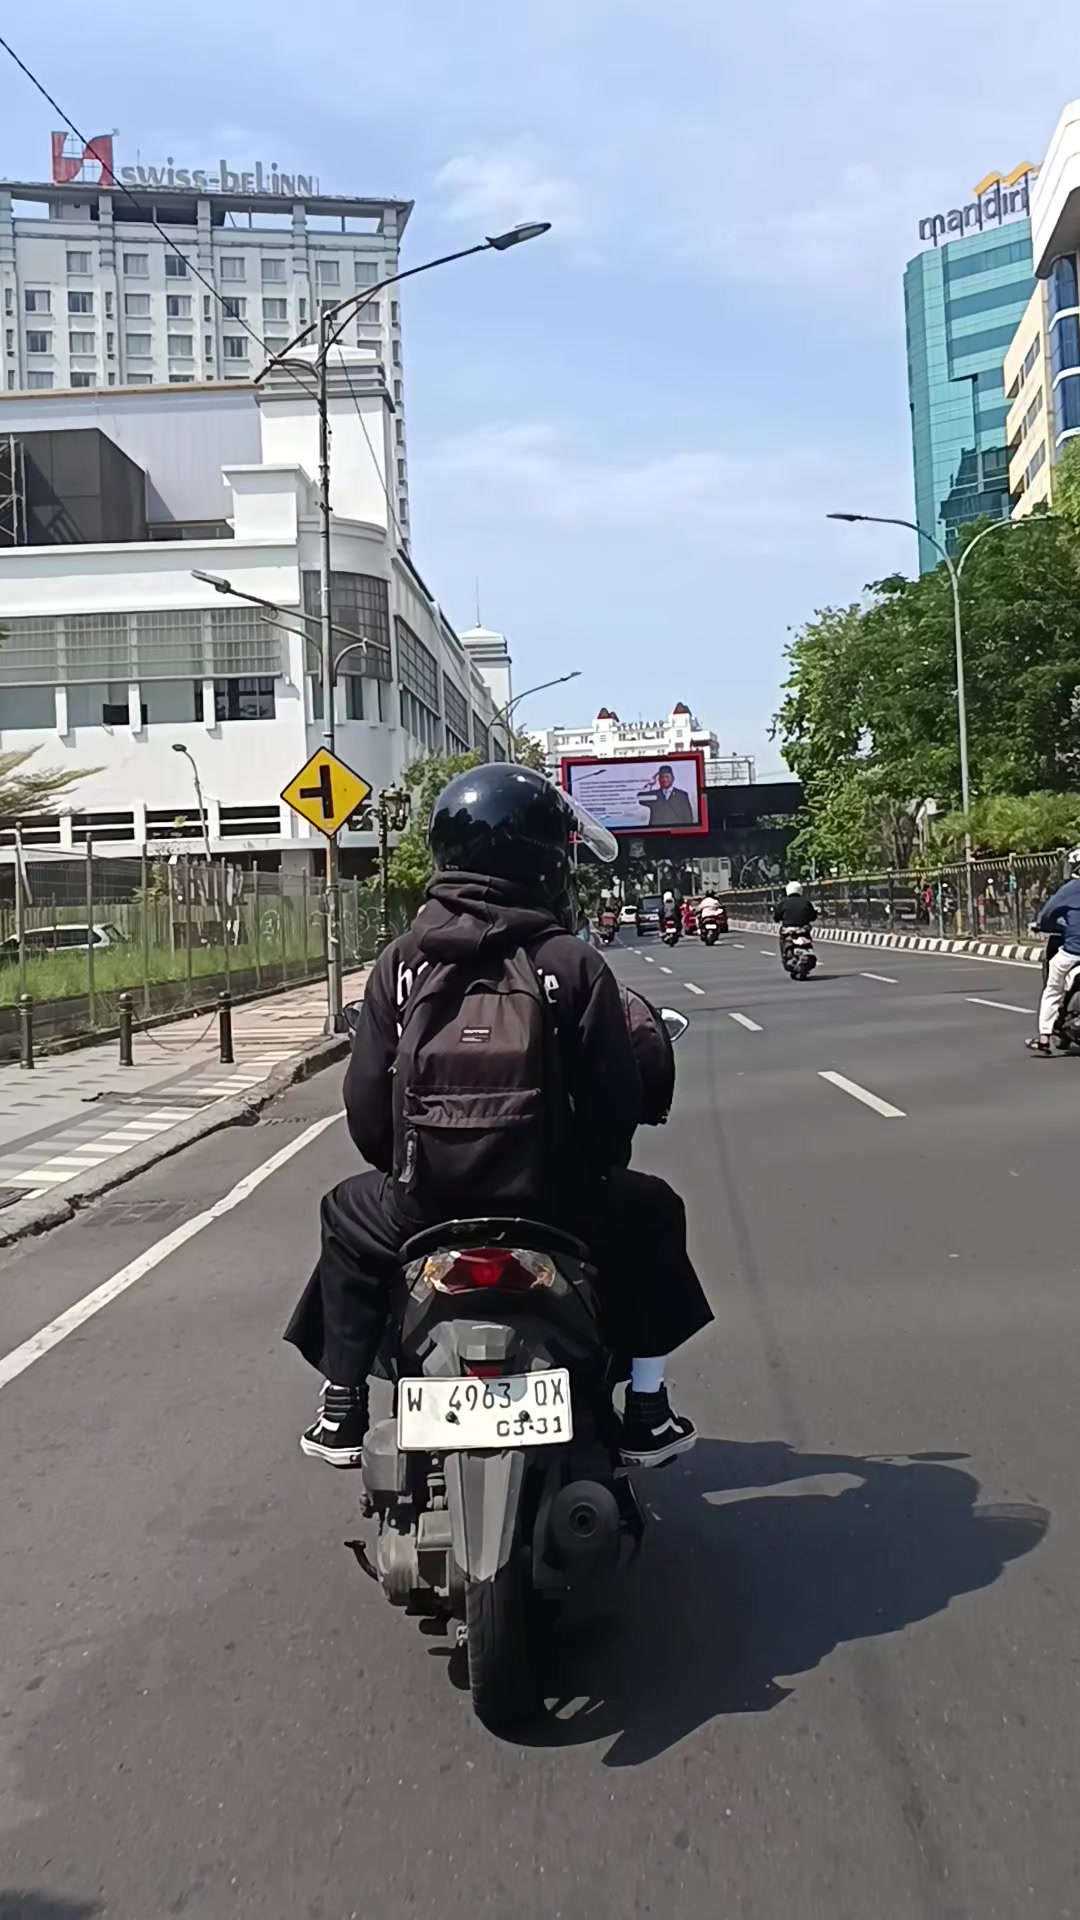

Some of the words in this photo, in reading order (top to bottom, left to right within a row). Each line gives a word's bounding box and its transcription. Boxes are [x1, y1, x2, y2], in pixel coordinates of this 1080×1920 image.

[919, 183, 1030, 242] mandiri
[407, 1387, 423, 1412] W
[448, 1382, 512, 1411] 4963
